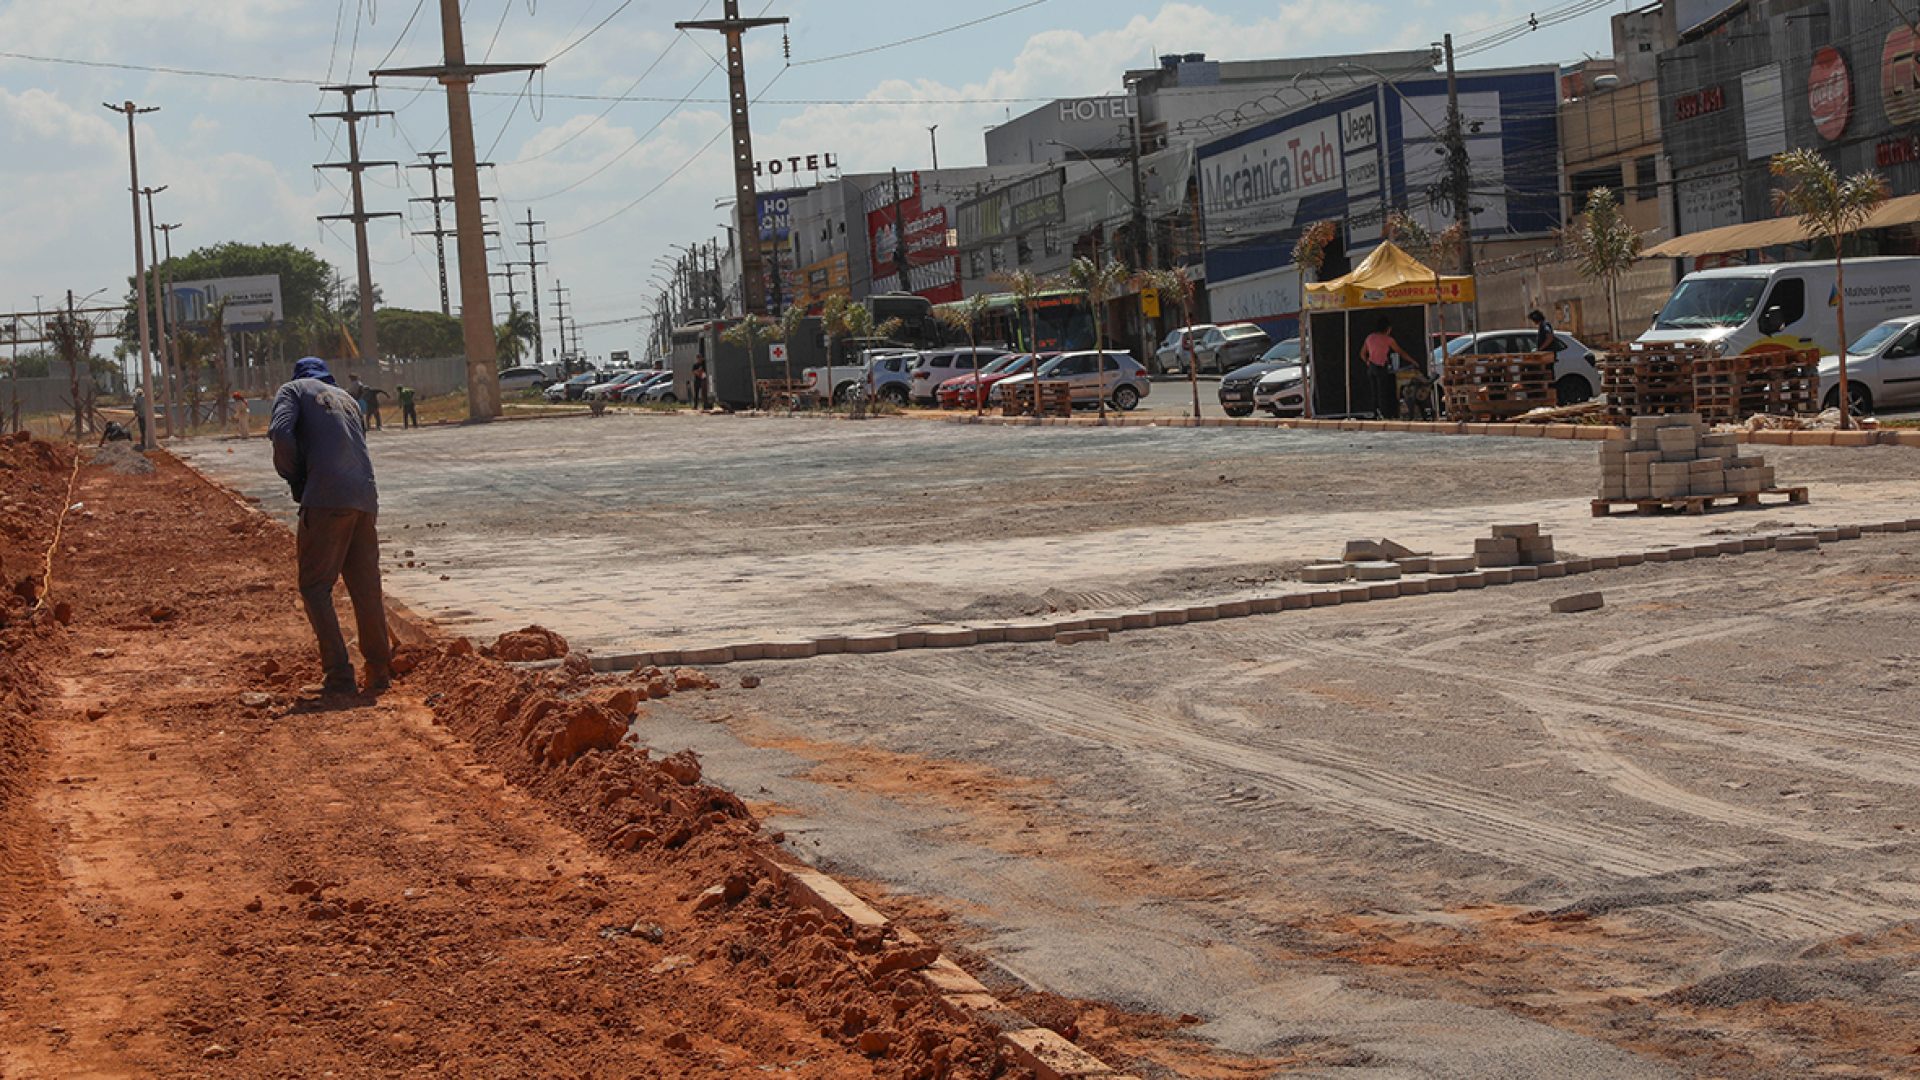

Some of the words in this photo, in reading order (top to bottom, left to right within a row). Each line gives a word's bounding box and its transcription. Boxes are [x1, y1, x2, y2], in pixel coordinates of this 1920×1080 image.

[1060, 98, 1137, 120] HOTEL
[1344, 112, 1373, 143] Jeep
[752, 153, 837, 176] HOTEL
[1206, 131, 1335, 214] MecânicaTech
[1386, 287, 1425, 297] COMPRE
